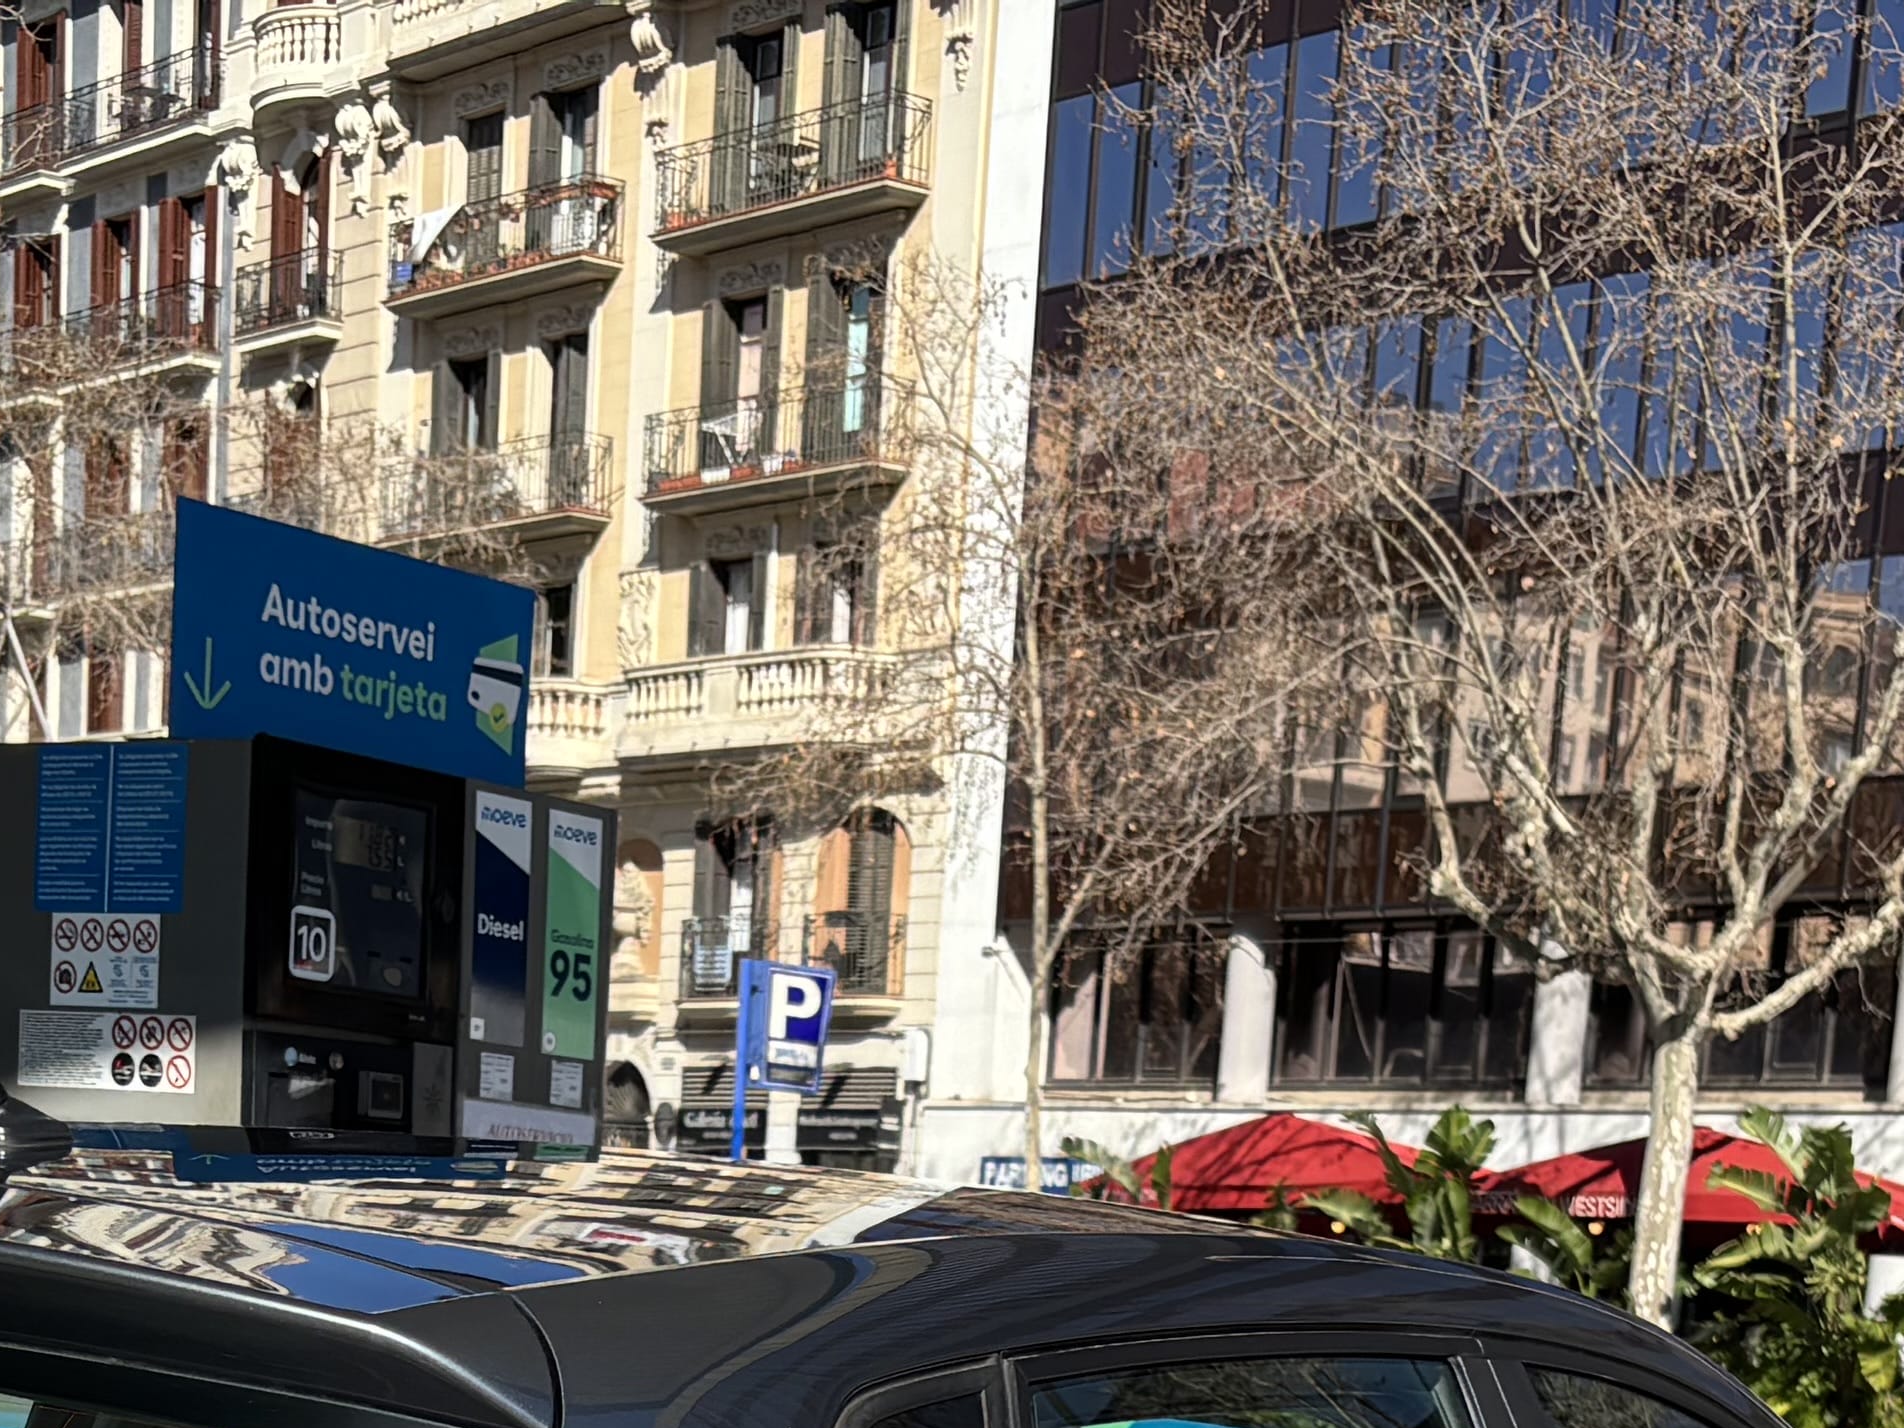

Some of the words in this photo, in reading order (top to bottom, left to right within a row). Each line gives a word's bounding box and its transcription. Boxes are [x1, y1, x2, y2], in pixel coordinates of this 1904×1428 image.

[261, 583, 436, 662] Autoservei
[260, 653, 334, 696] amb
[340, 664, 447, 722] tarjeta
[481, 807, 527, 828] moeve
[554, 824, 597, 845] moeve
[297, 924, 327, 962] 10
[478, 913, 524, 941] Diesel
[550, 950, 592, 1002] 95
[768, 973, 822, 1039] P
[984, 1162, 1069, 1187] PARNG
